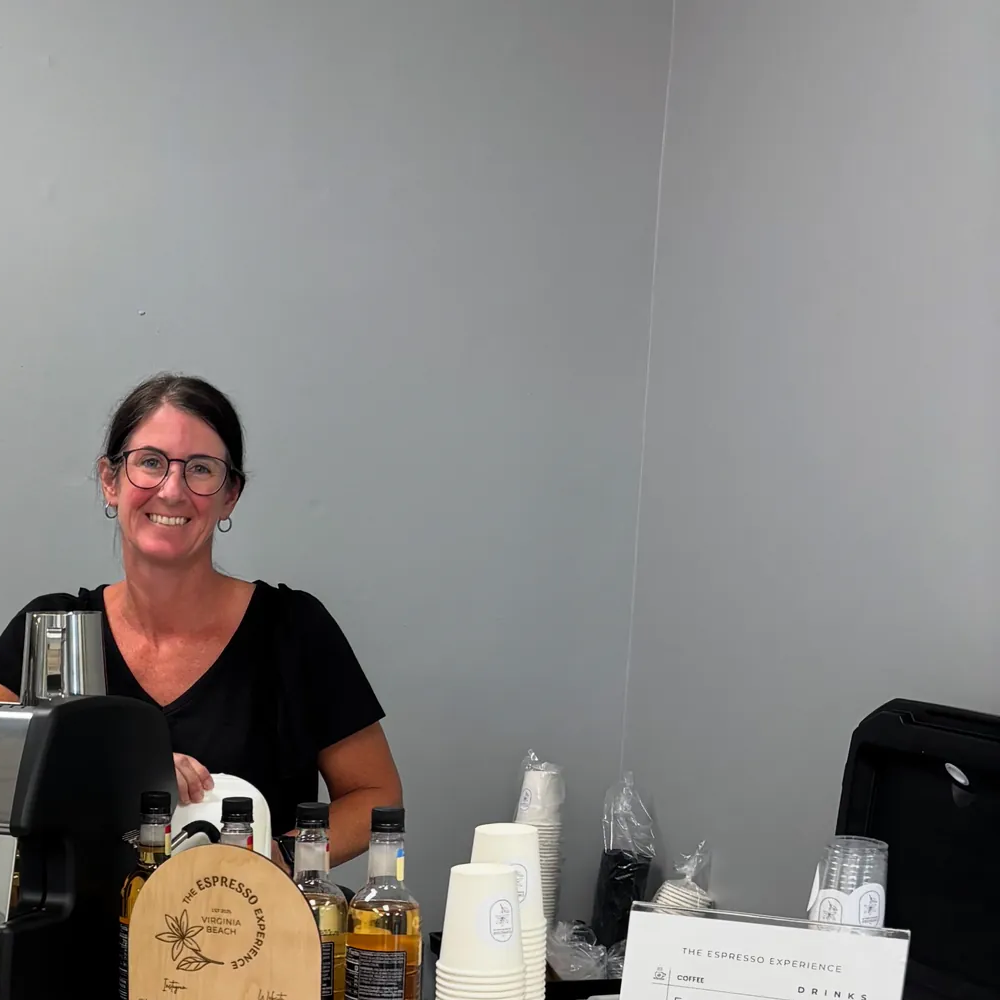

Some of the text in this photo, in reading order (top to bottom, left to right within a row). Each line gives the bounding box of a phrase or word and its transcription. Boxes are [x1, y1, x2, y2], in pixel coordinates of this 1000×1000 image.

[182, 875, 266, 970] THE ESPRESSO EXPERIENCE
[201, 916, 242, 927] VIRGINIA
[206, 925, 237, 936] BEACH
[682, 947, 843, 974] THE ESPRESSO EXPERIENCE
[676, 974, 705, 984] COFFEE
